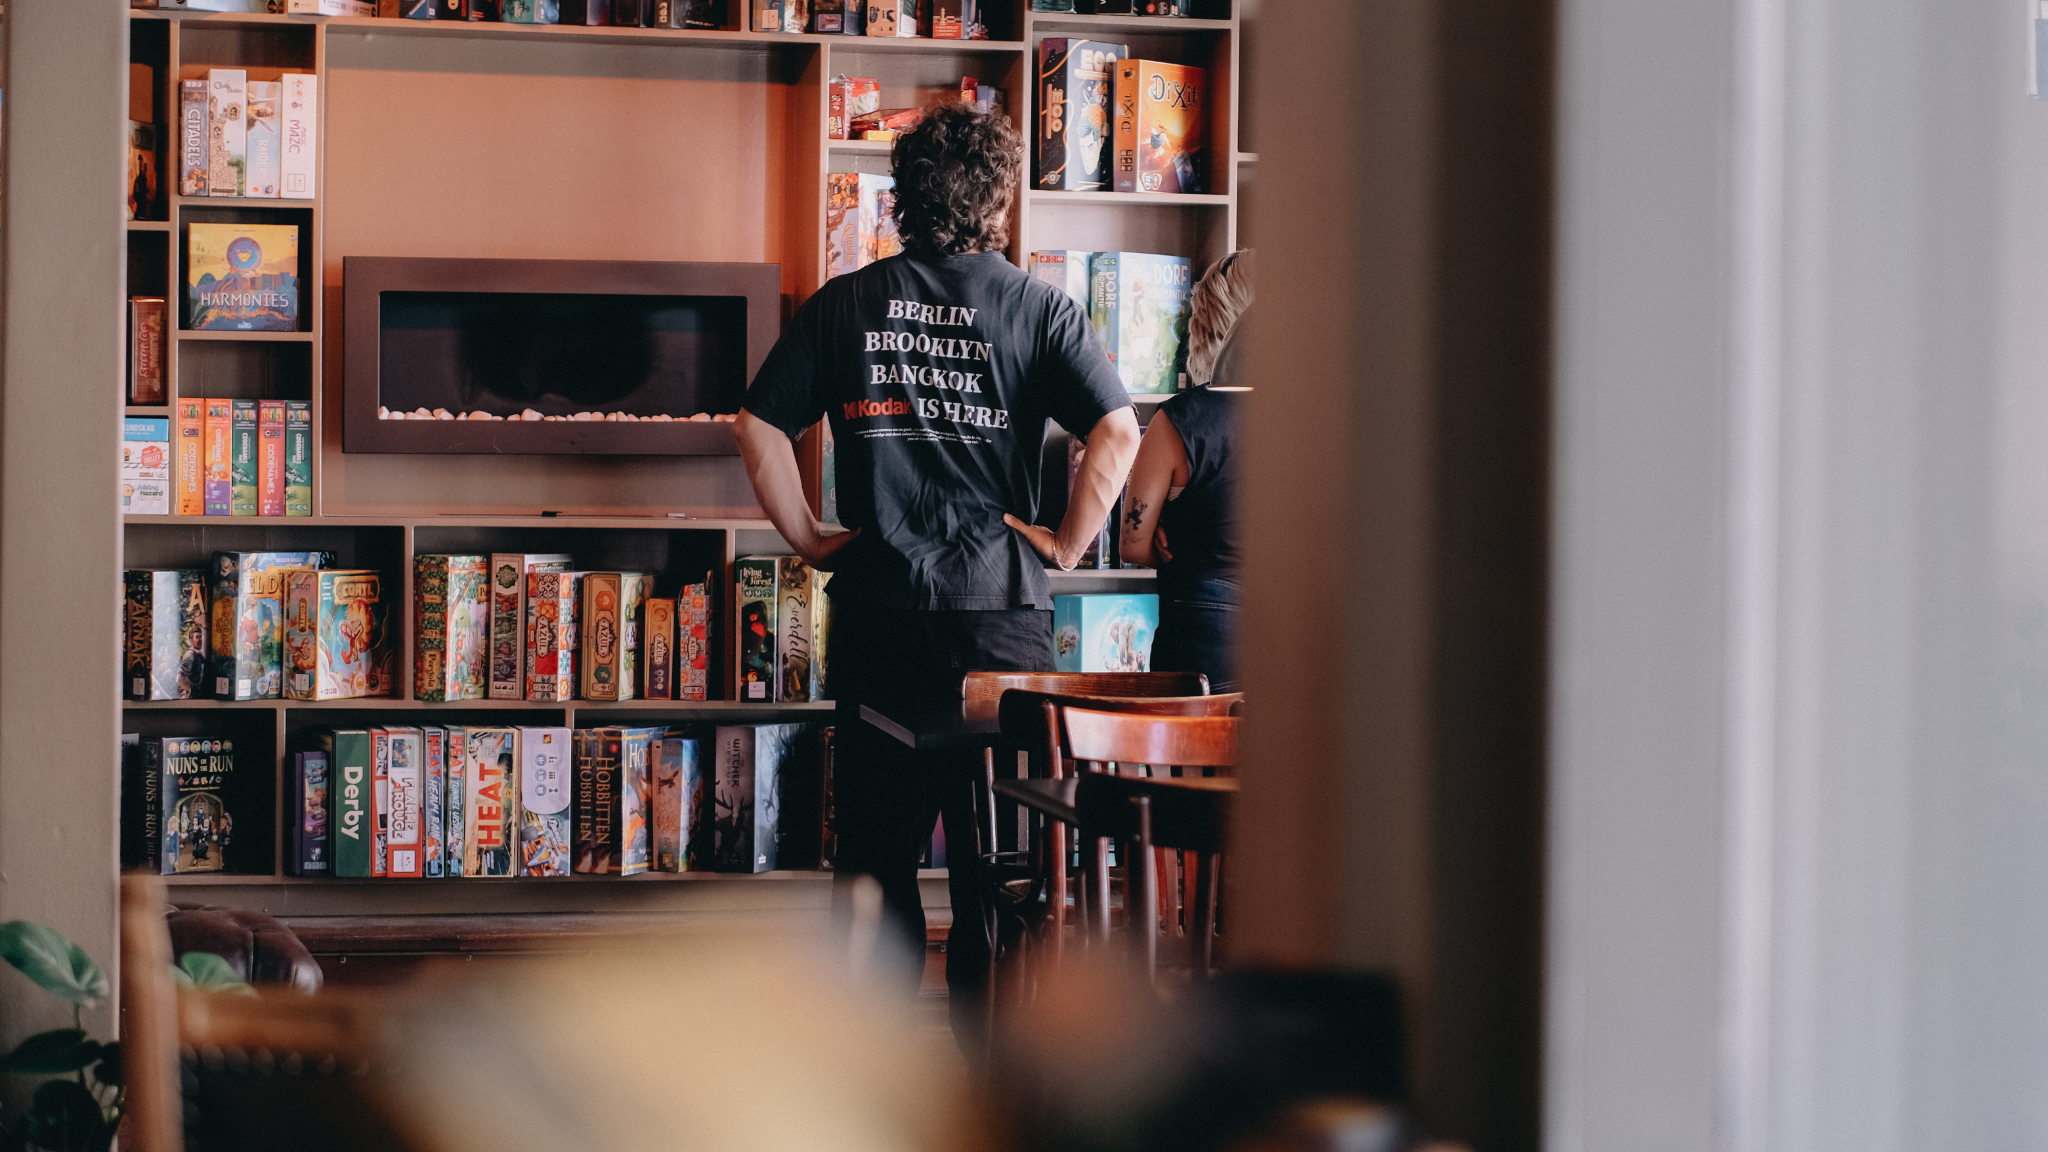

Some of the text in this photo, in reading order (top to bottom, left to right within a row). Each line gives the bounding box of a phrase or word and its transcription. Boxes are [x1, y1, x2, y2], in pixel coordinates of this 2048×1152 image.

[187, 108, 201, 168] CITADELS
[289, 120, 300, 154] MAZE
[258, 140, 269, 181] RAIDERS
[1098, 272, 1106, 308] ROMANTIK
[1106, 271, 1117, 310] DORF
[1153, 263, 1189, 286] DORF
[201, 292, 289, 308] HARMONIES
[886, 300, 978, 326] BERLIN
[140, 344, 150, 378] SUSHI
[864, 331, 992, 362] BROOKLYN
[870, 364, 983, 394] BANGKOK
[858, 398, 1008, 429] Kodak IS HERE
[188, 442, 196, 493] CODENAMES
[267, 444, 275, 494] CODENAMES
[132, 601, 147, 668] ARNAK
[425, 653, 436, 688] Pergola
[166, 756, 198, 775] NUNS
[209, 755, 234, 772] RUN
[428, 736, 440, 778] HEAT
[451, 736, 464, 778] HEAT
[732, 739, 740, 788] WITCHER
[146, 770, 156, 802] NUNS
[341, 766, 364, 840] Derby
[428, 779, 438, 814] HEAVY
[452, 780, 460, 809] TUNNEL
[478, 763, 502, 844] HEAT
[596, 756, 615, 844] HOBBITTEN
[392, 792, 404, 839] ROUGE
[402, 778, 415, 831] FLAMME
[146, 814, 156, 838] RUN
